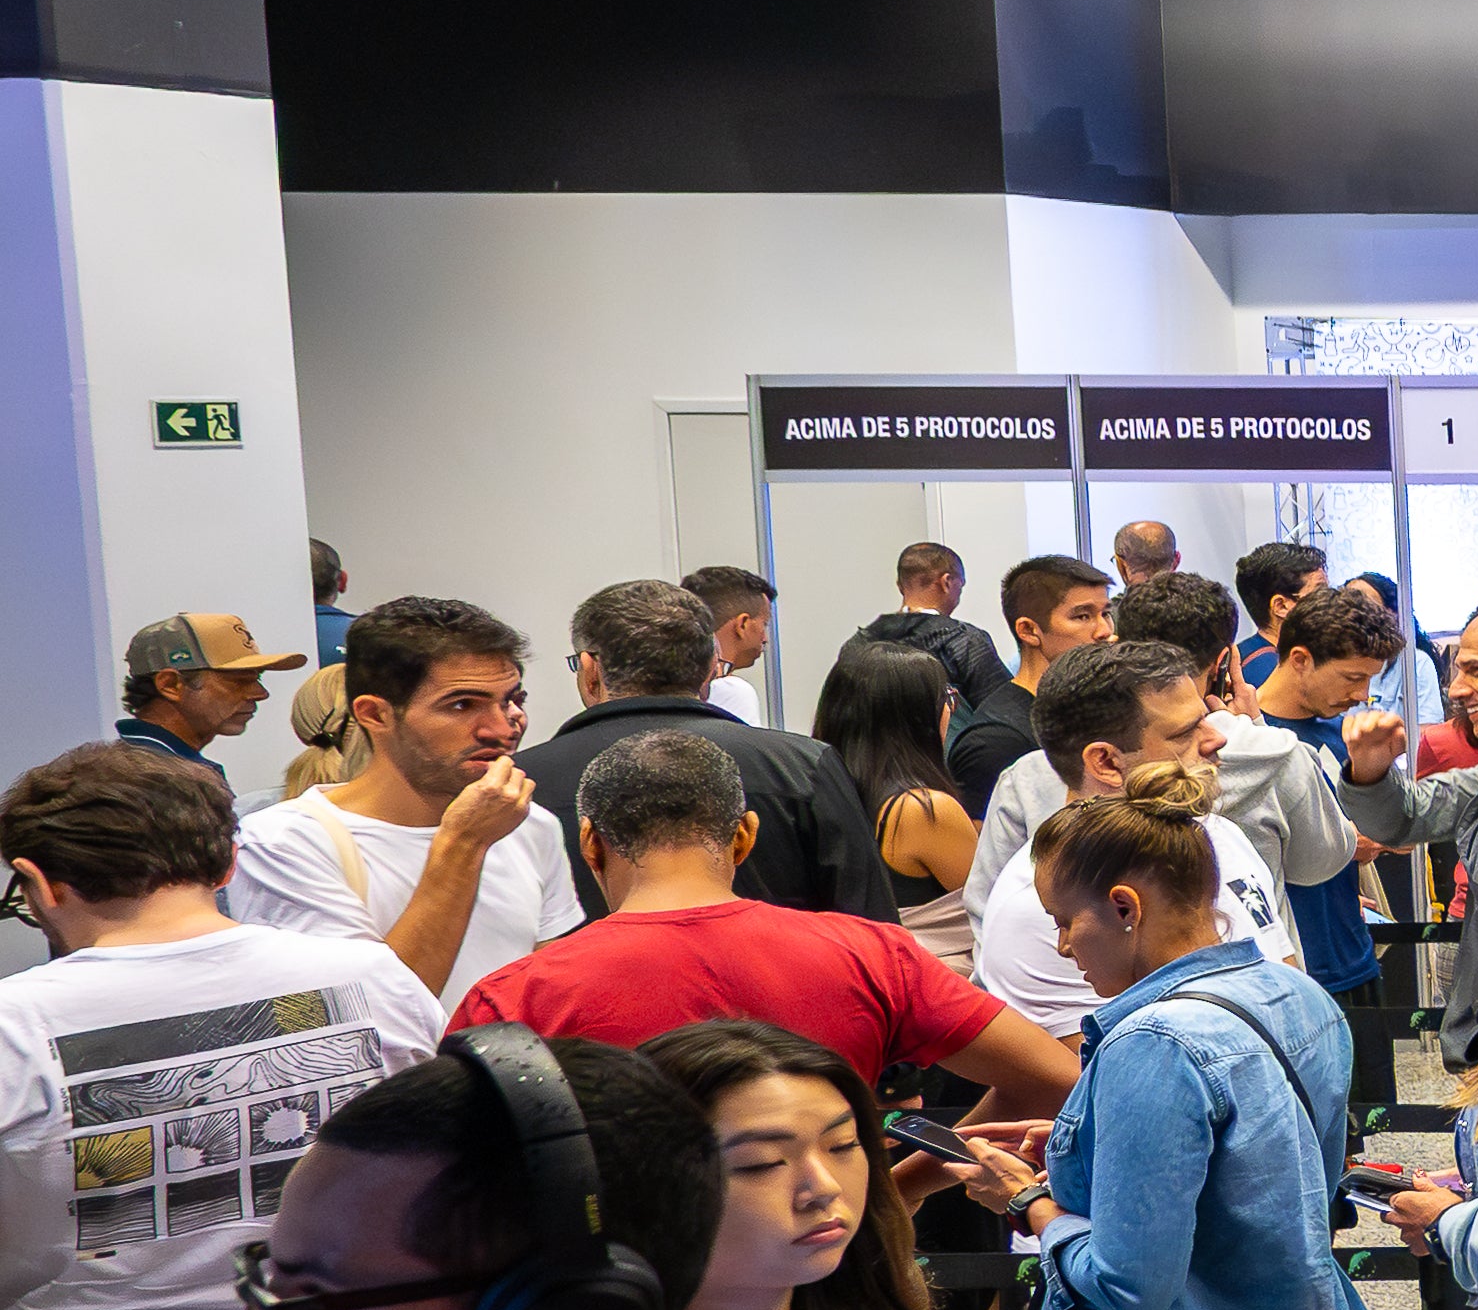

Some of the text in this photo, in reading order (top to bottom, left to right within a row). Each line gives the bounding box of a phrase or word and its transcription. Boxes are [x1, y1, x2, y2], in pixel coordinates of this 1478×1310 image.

[785, 416, 1056, 440] ACIMA DE 5 PROTOCOLOS
[1099, 417, 1371, 441] ACIMA DE 5 PROTOCOLOS
[1442, 418, 1454, 445] 1
